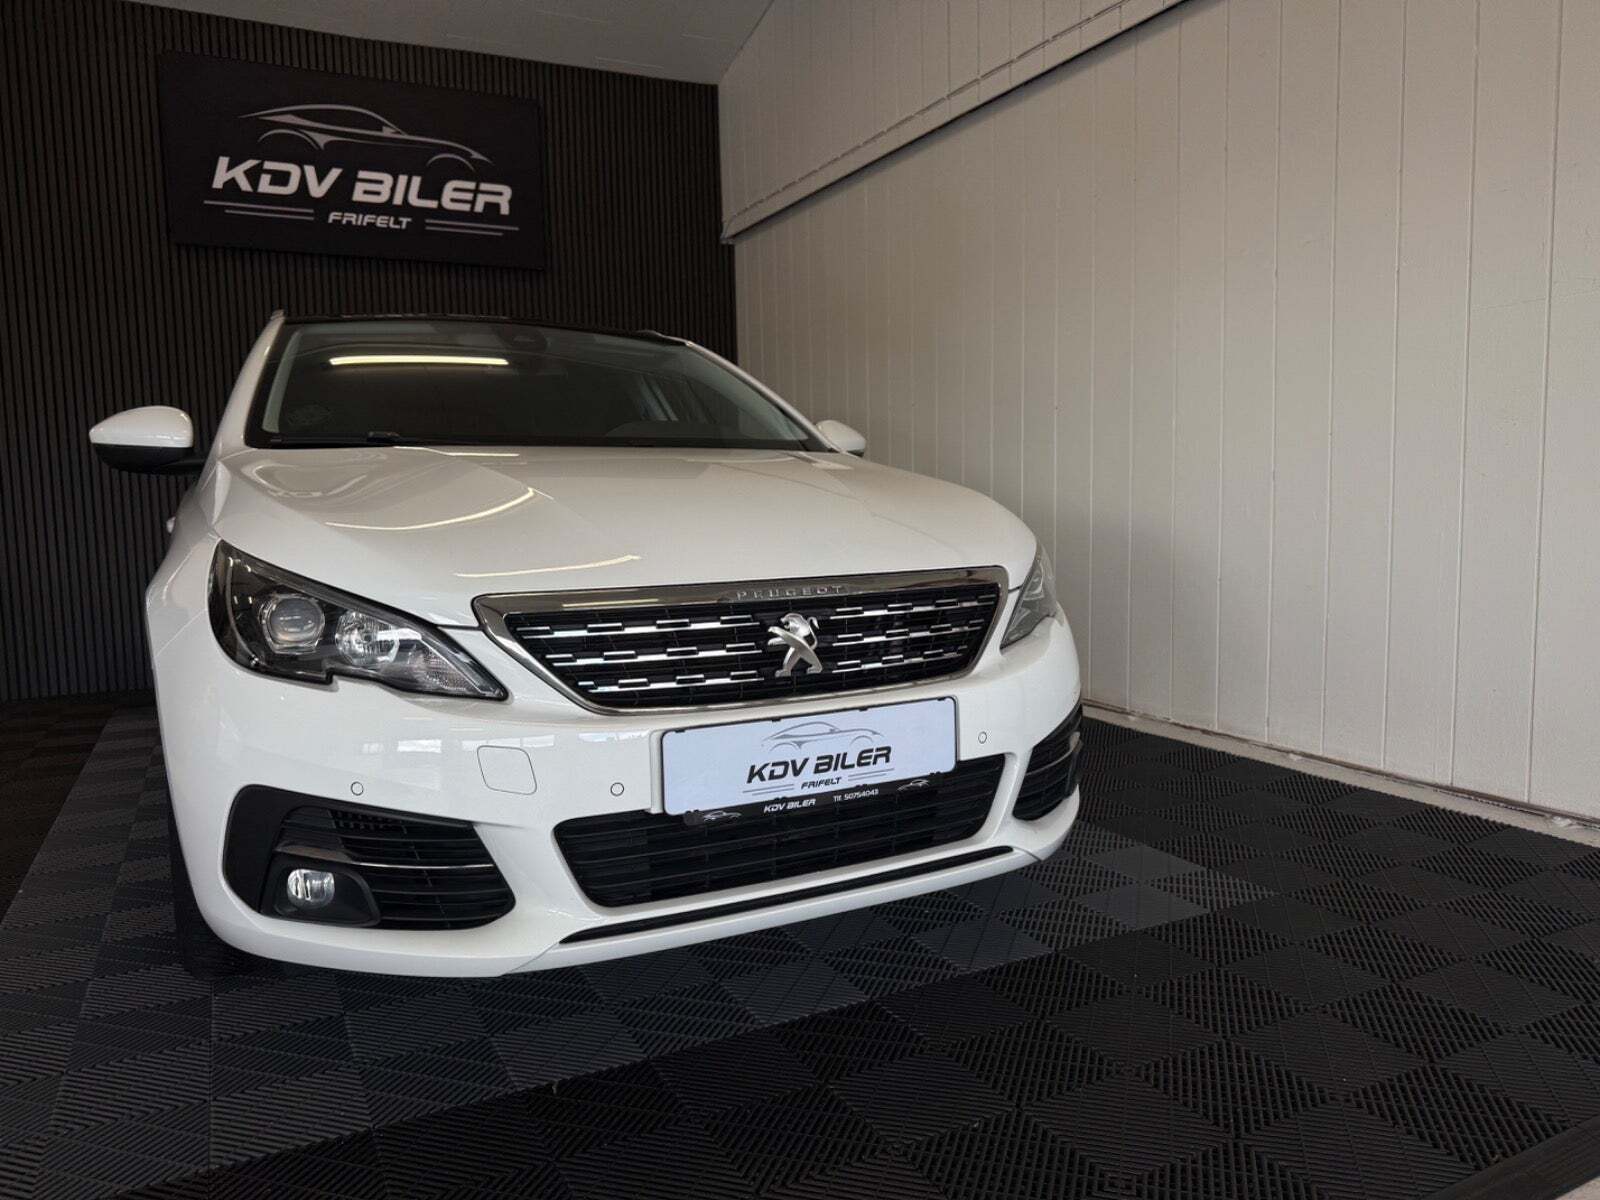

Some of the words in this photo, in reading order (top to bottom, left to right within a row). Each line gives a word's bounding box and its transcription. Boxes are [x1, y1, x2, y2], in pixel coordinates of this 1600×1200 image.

[211, 155, 343, 199] KDV
[352, 170, 513, 215] BILER
[328, 211, 412, 230] FRIFELT
[736, 585, 841, 599] PEUGEOT
[746, 757, 809, 784] KDV
[813, 746, 892, 774] BILER
[801, 777, 842, 790] FRIFELT
[763, 803, 786, 814] KDV
[786, 798, 816, 810] BILER
